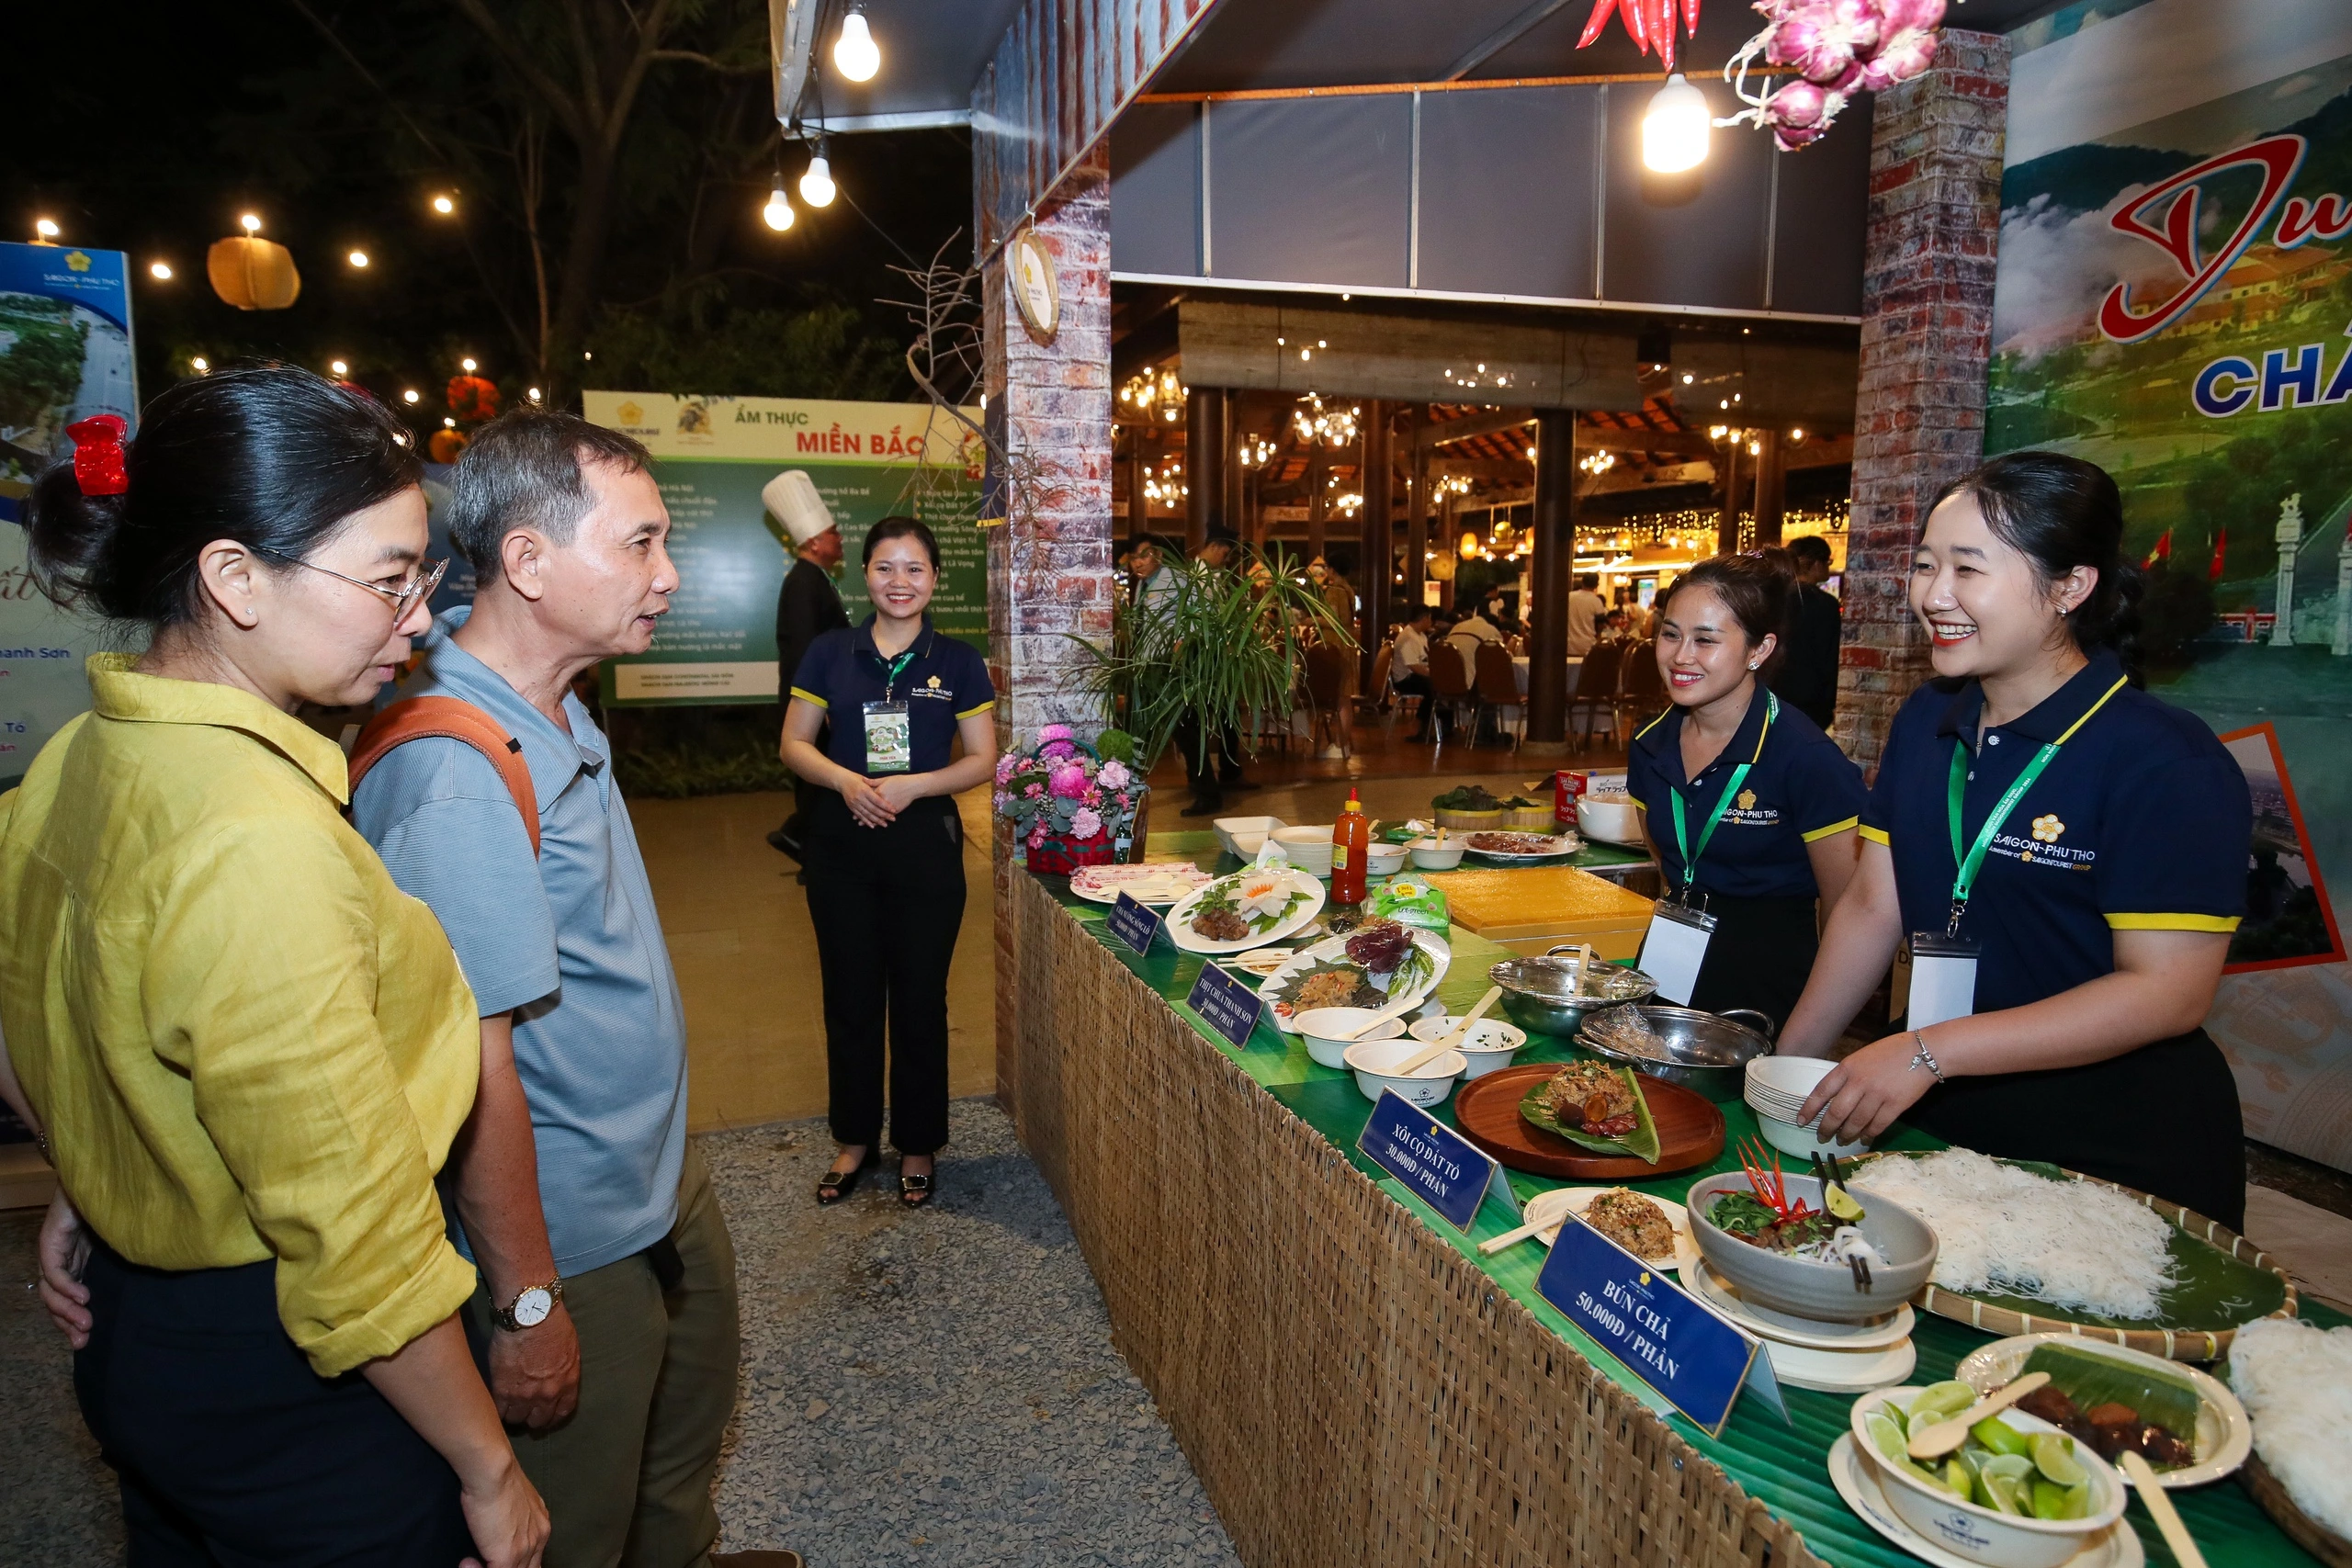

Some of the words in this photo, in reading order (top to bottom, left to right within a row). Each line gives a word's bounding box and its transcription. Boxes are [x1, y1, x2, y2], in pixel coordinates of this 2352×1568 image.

[765, 411, 808, 428] THỰC
[797, 422, 862, 455] MIỀN
[870, 424, 924, 456] BẮC
[1763, 809, 1778, 819] THO
[2069, 849, 2096, 862] THO
[1199, 978, 1213, 993] THỊT
[1210, 987, 1225, 1004] CHUA
[1223, 996, 1243, 1017] THANH
[1392, 1123, 1411, 1145] XÔI
[1409, 1137, 1424, 1156] CỌ
[1385, 1143, 1418, 1174] 30.000Đ
[1602, 1279, 1637, 1314] BÚN
[1634, 1304, 1672, 1342] CHẢ
[1576, 1291, 1626, 1337] 50.000Đ
[1632, 1334, 1680, 1380] PHẦN
